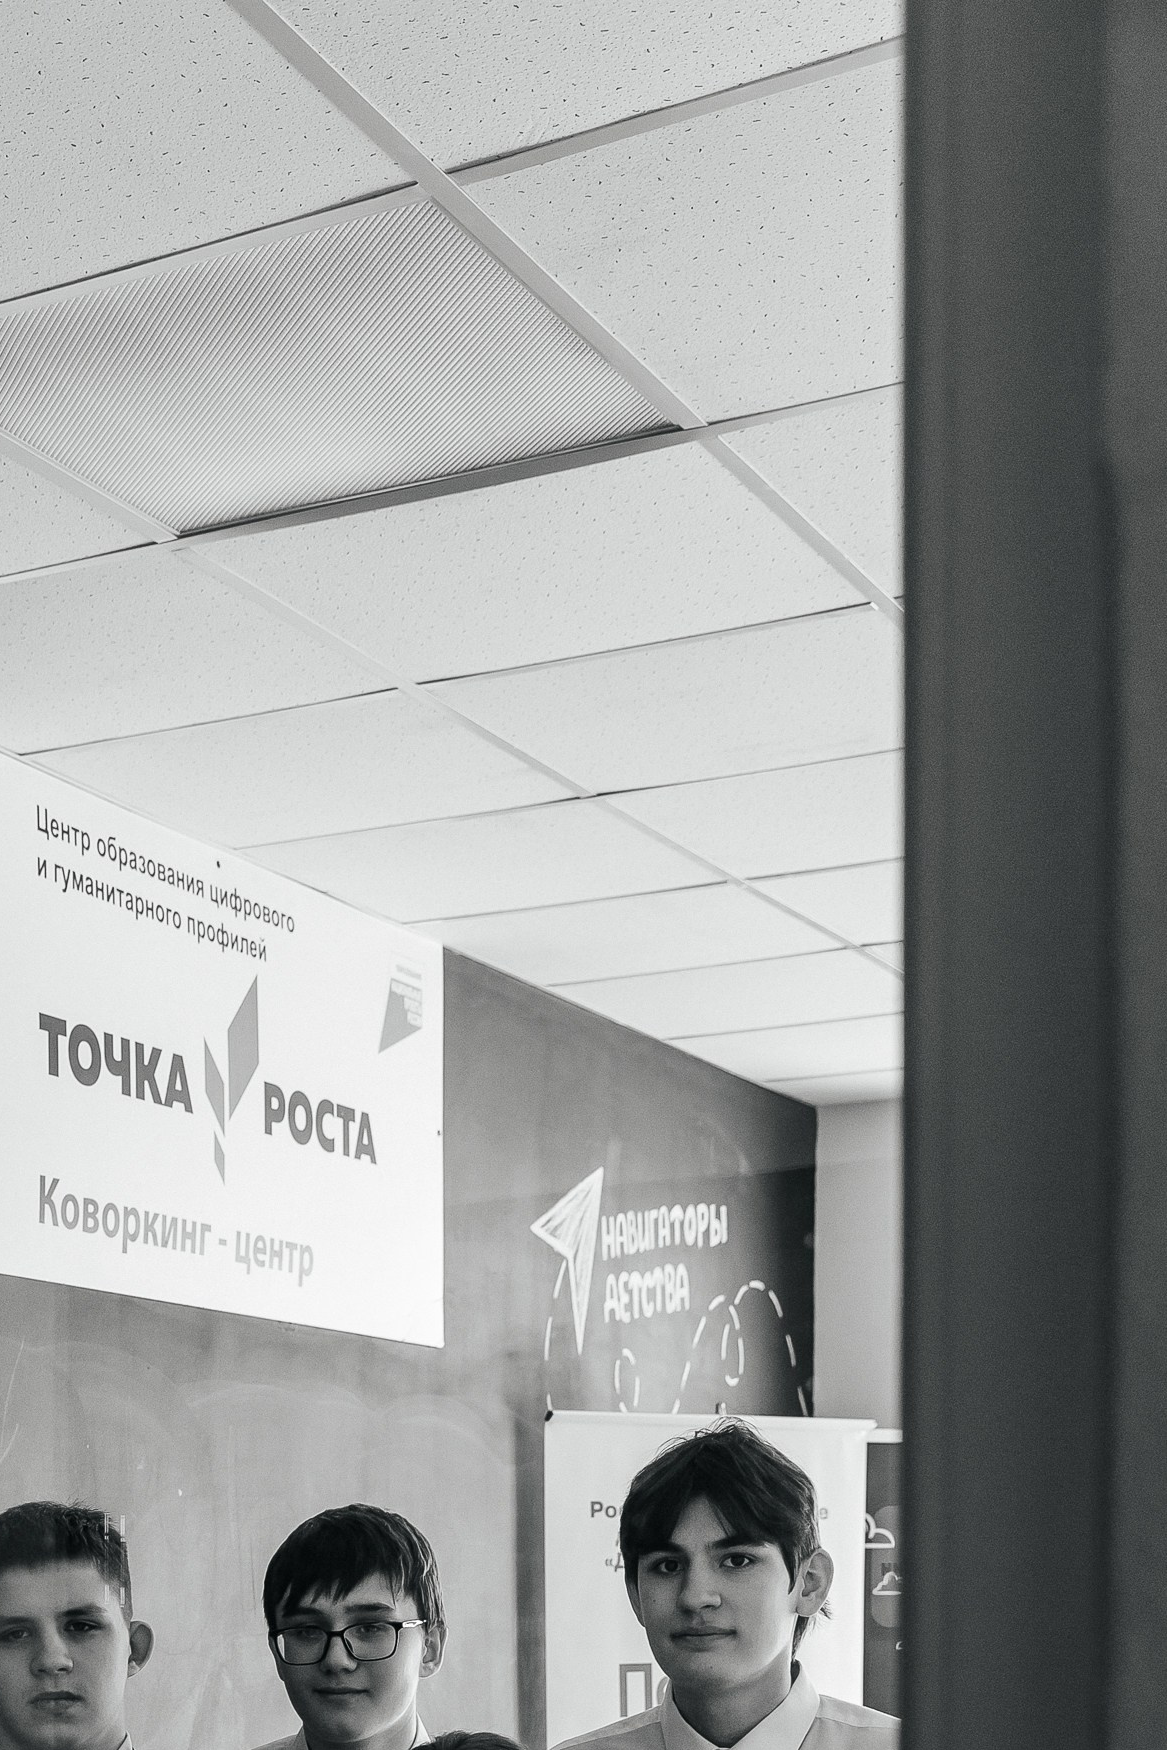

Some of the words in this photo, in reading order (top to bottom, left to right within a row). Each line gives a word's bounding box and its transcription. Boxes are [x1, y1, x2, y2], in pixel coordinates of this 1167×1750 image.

[36, 804, 91, 857] Центр
[96, 836, 205, 898] образования
[209, 884, 295, 933] цифрового
[37, 856, 48, 880] и
[53, 863, 182, 930] гуманитарного
[186, 916, 267, 962] профилей
[38, 1011, 194, 1115] ТОЧКА
[263, 1080, 378, 1165] РОСТА
[601, 1202, 729, 1261] НАВИГАТОРЫ
[603, 1262, 691, 1324] ДЕТСТВА
